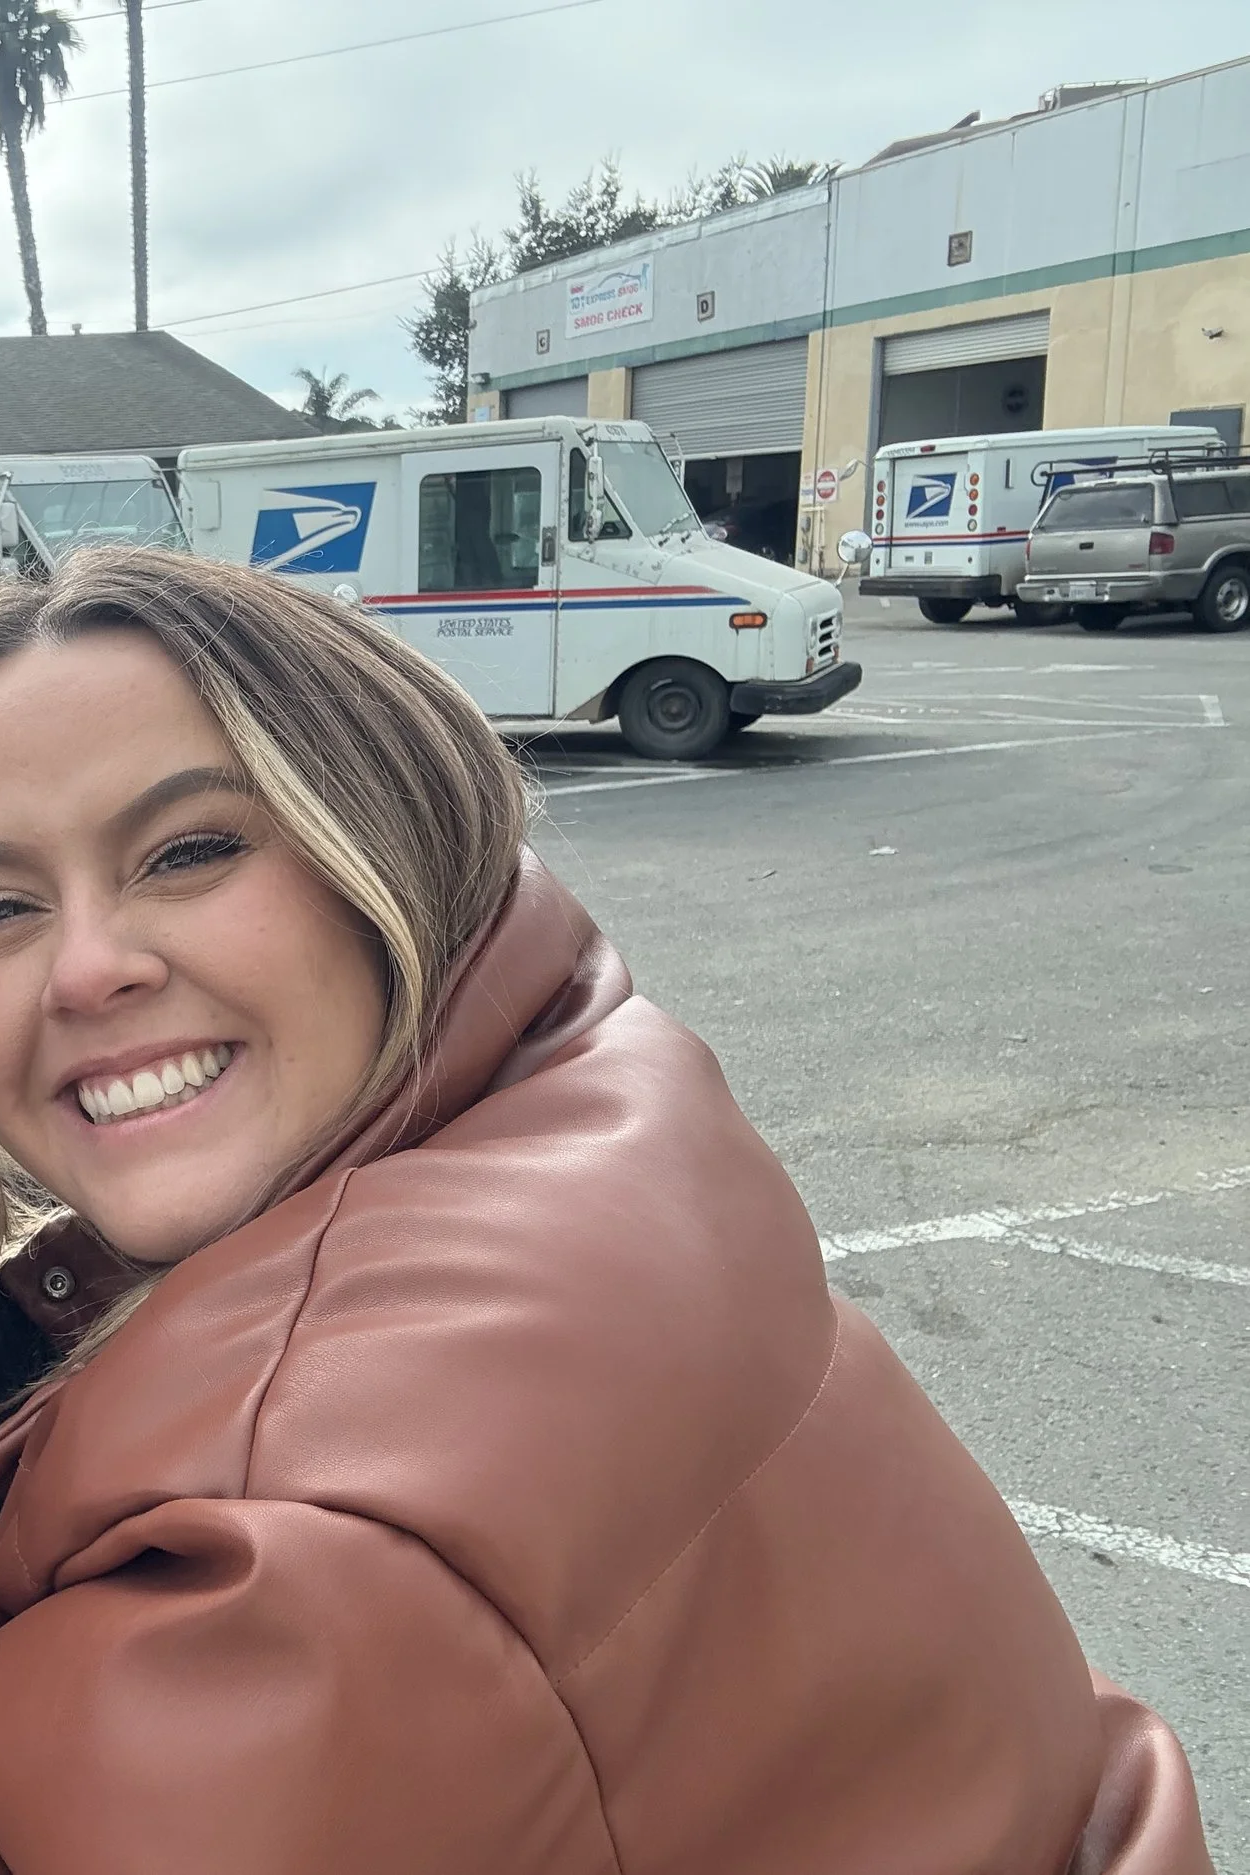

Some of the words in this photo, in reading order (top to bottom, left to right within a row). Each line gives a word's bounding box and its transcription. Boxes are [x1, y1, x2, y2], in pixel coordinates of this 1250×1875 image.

[574, 313, 604, 330] SMOG
[607, 303, 643, 322] CHECK
[439, 618, 476, 628] UNITED
[477, 617, 512, 627] STATES
[437, 627, 472, 637] POSTAL
[475, 626, 514, 637] SERVICE
